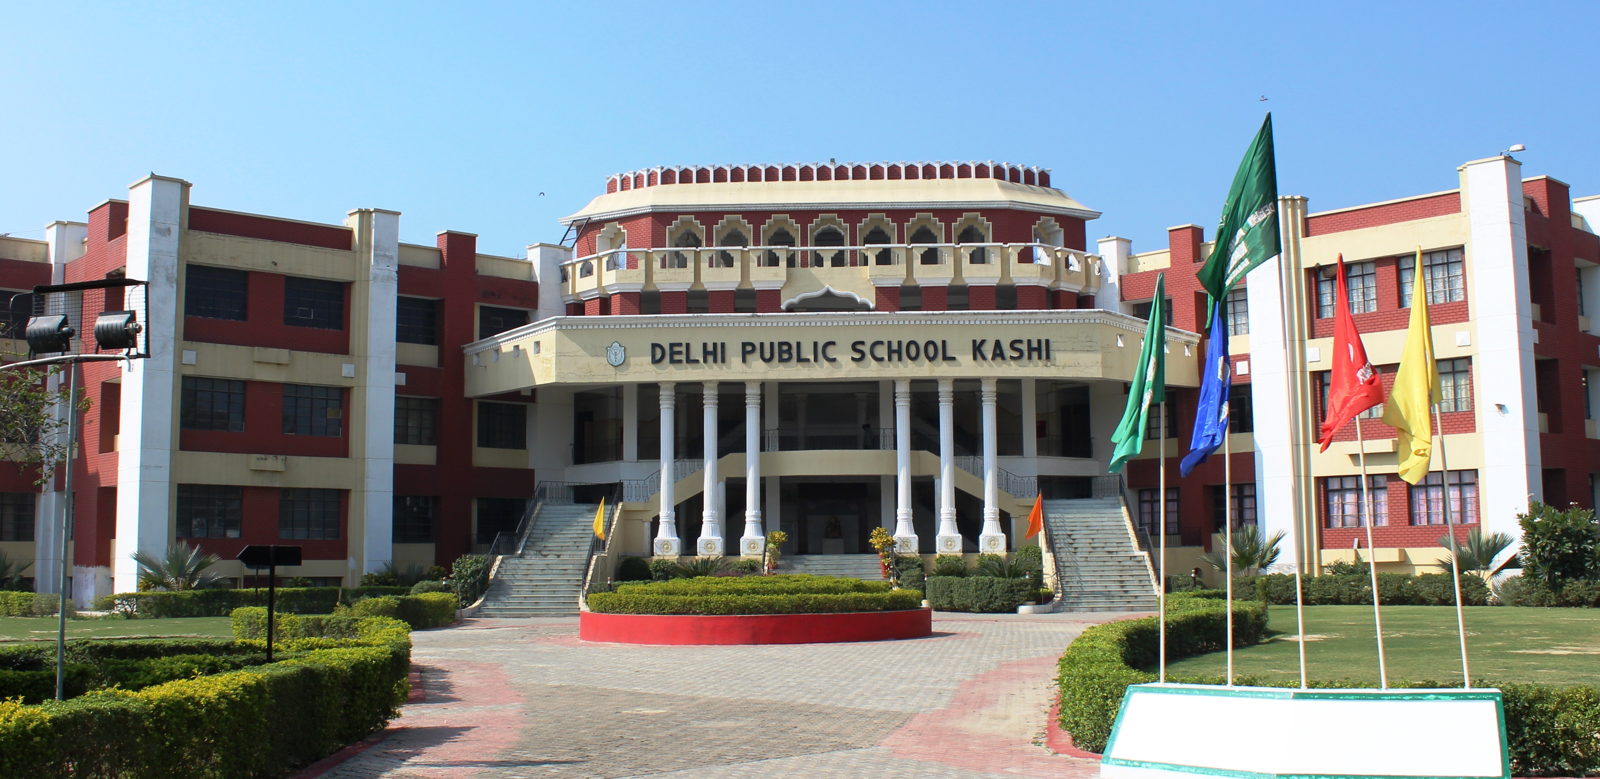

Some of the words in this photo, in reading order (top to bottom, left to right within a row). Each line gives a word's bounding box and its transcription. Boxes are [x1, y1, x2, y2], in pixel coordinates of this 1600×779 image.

[650, 342, 726, 364] DELHI
[741, 341, 837, 363] PUBLIC
[850, 339, 957, 362] SCHOOL
[971, 338, 1051, 361] KASHI
